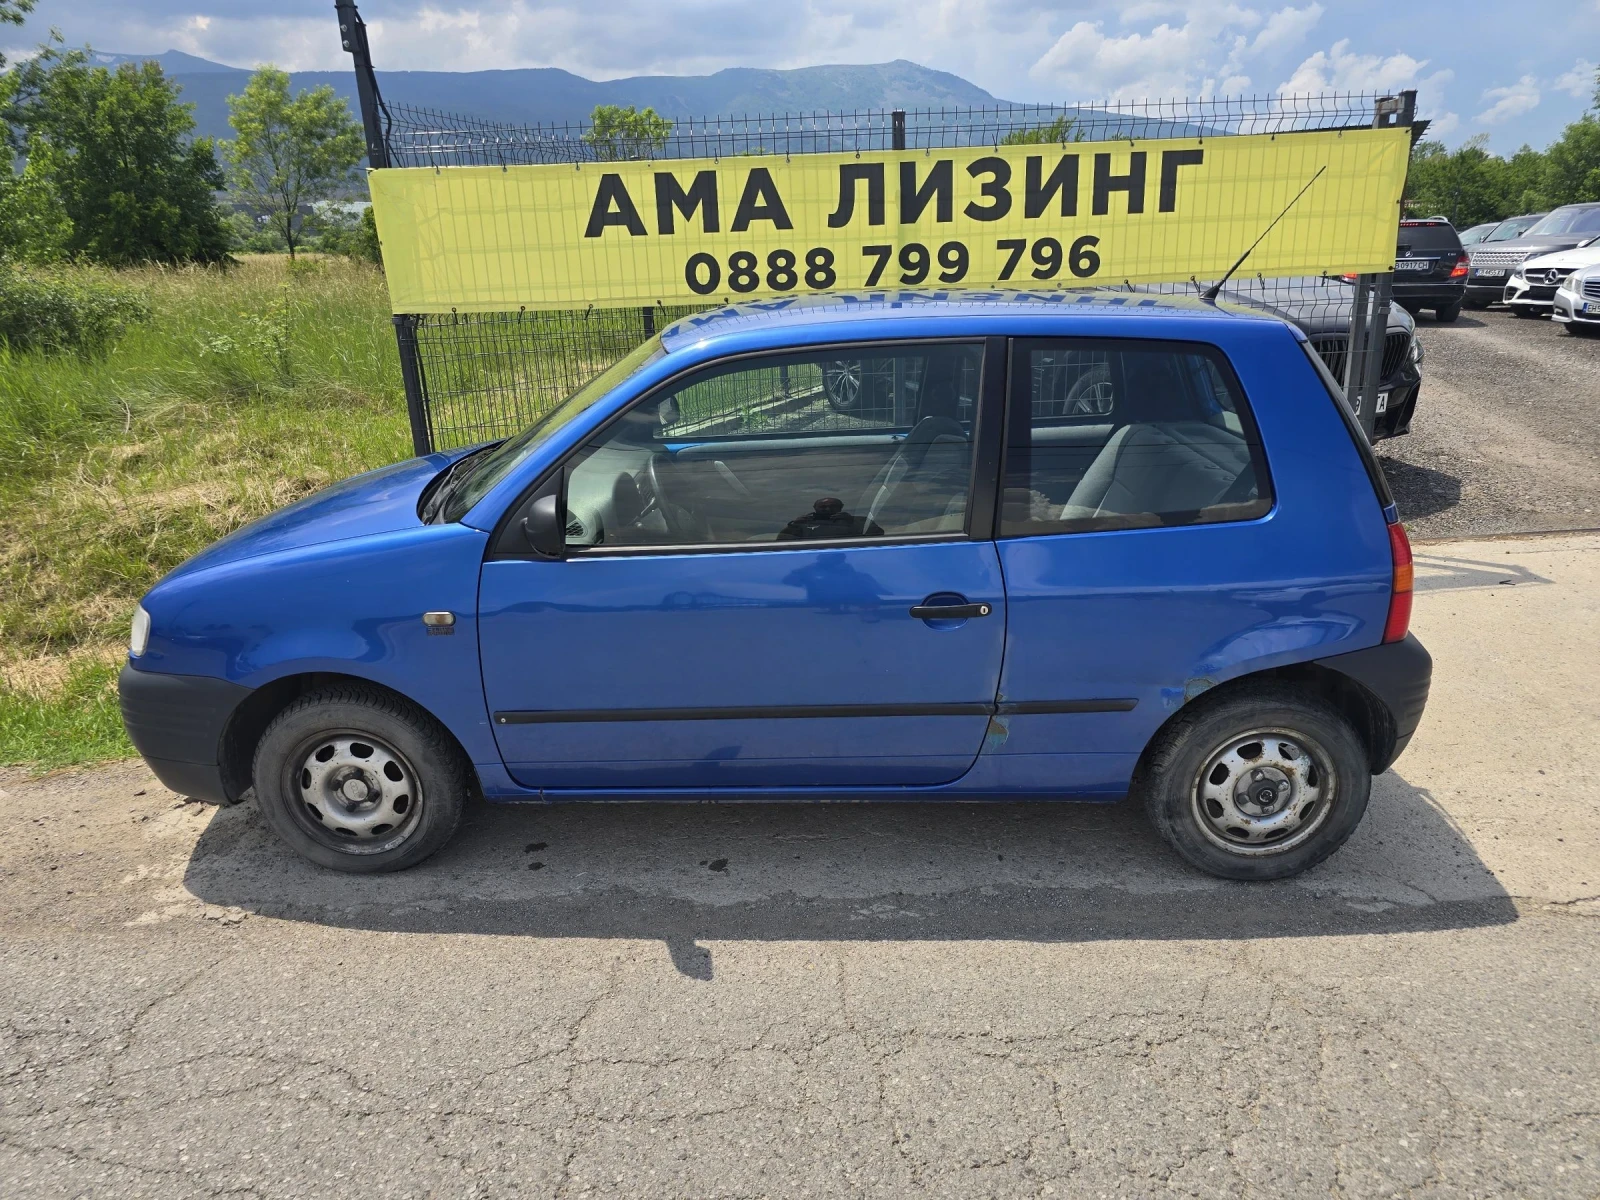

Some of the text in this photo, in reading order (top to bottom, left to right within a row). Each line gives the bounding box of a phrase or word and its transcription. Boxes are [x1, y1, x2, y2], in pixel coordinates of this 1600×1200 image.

[584, 148, 1204, 238] АМА ЛИЗИНГ
[684, 235, 1101, 295] 0888 799 796
